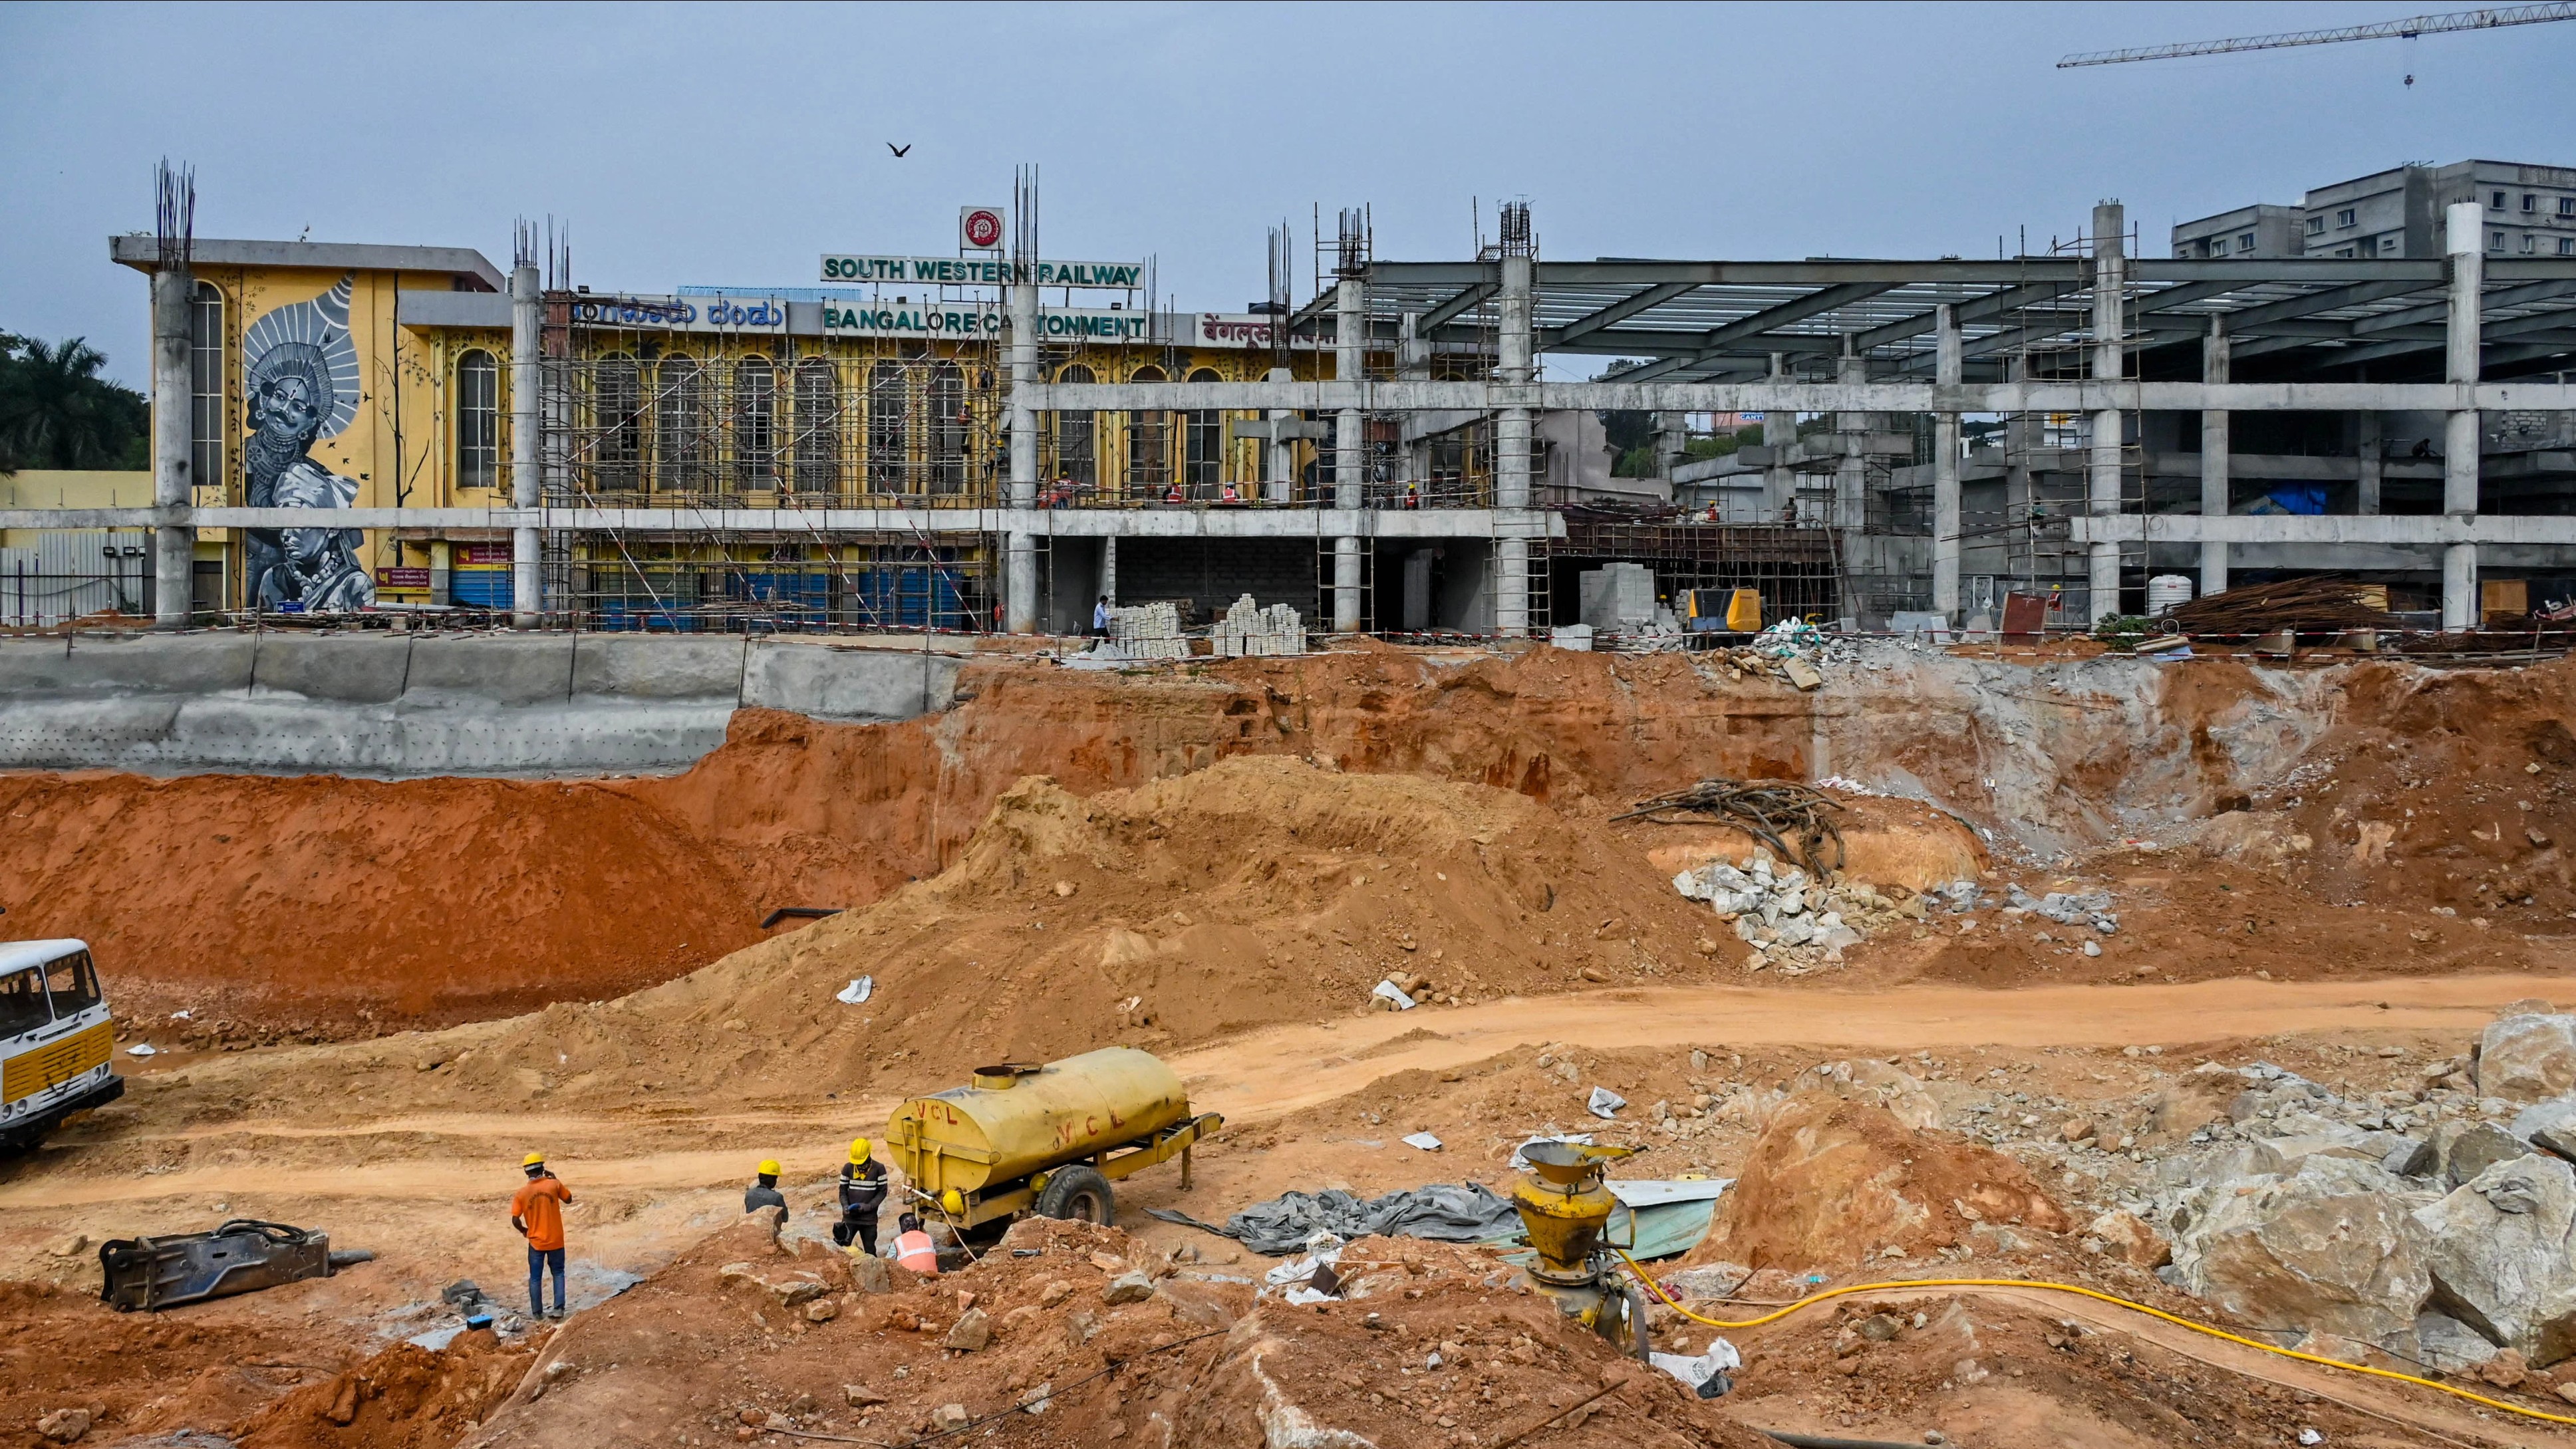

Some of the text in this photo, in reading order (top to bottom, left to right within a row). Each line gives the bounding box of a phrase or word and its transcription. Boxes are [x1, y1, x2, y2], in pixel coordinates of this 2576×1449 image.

[825, 259, 904, 278] SOUTH
[1038, 264, 1140, 285] RAILWAY
[708, 300, 783, 326] ದಂಡು
[824, 309, 978, 332] BANGALORE
